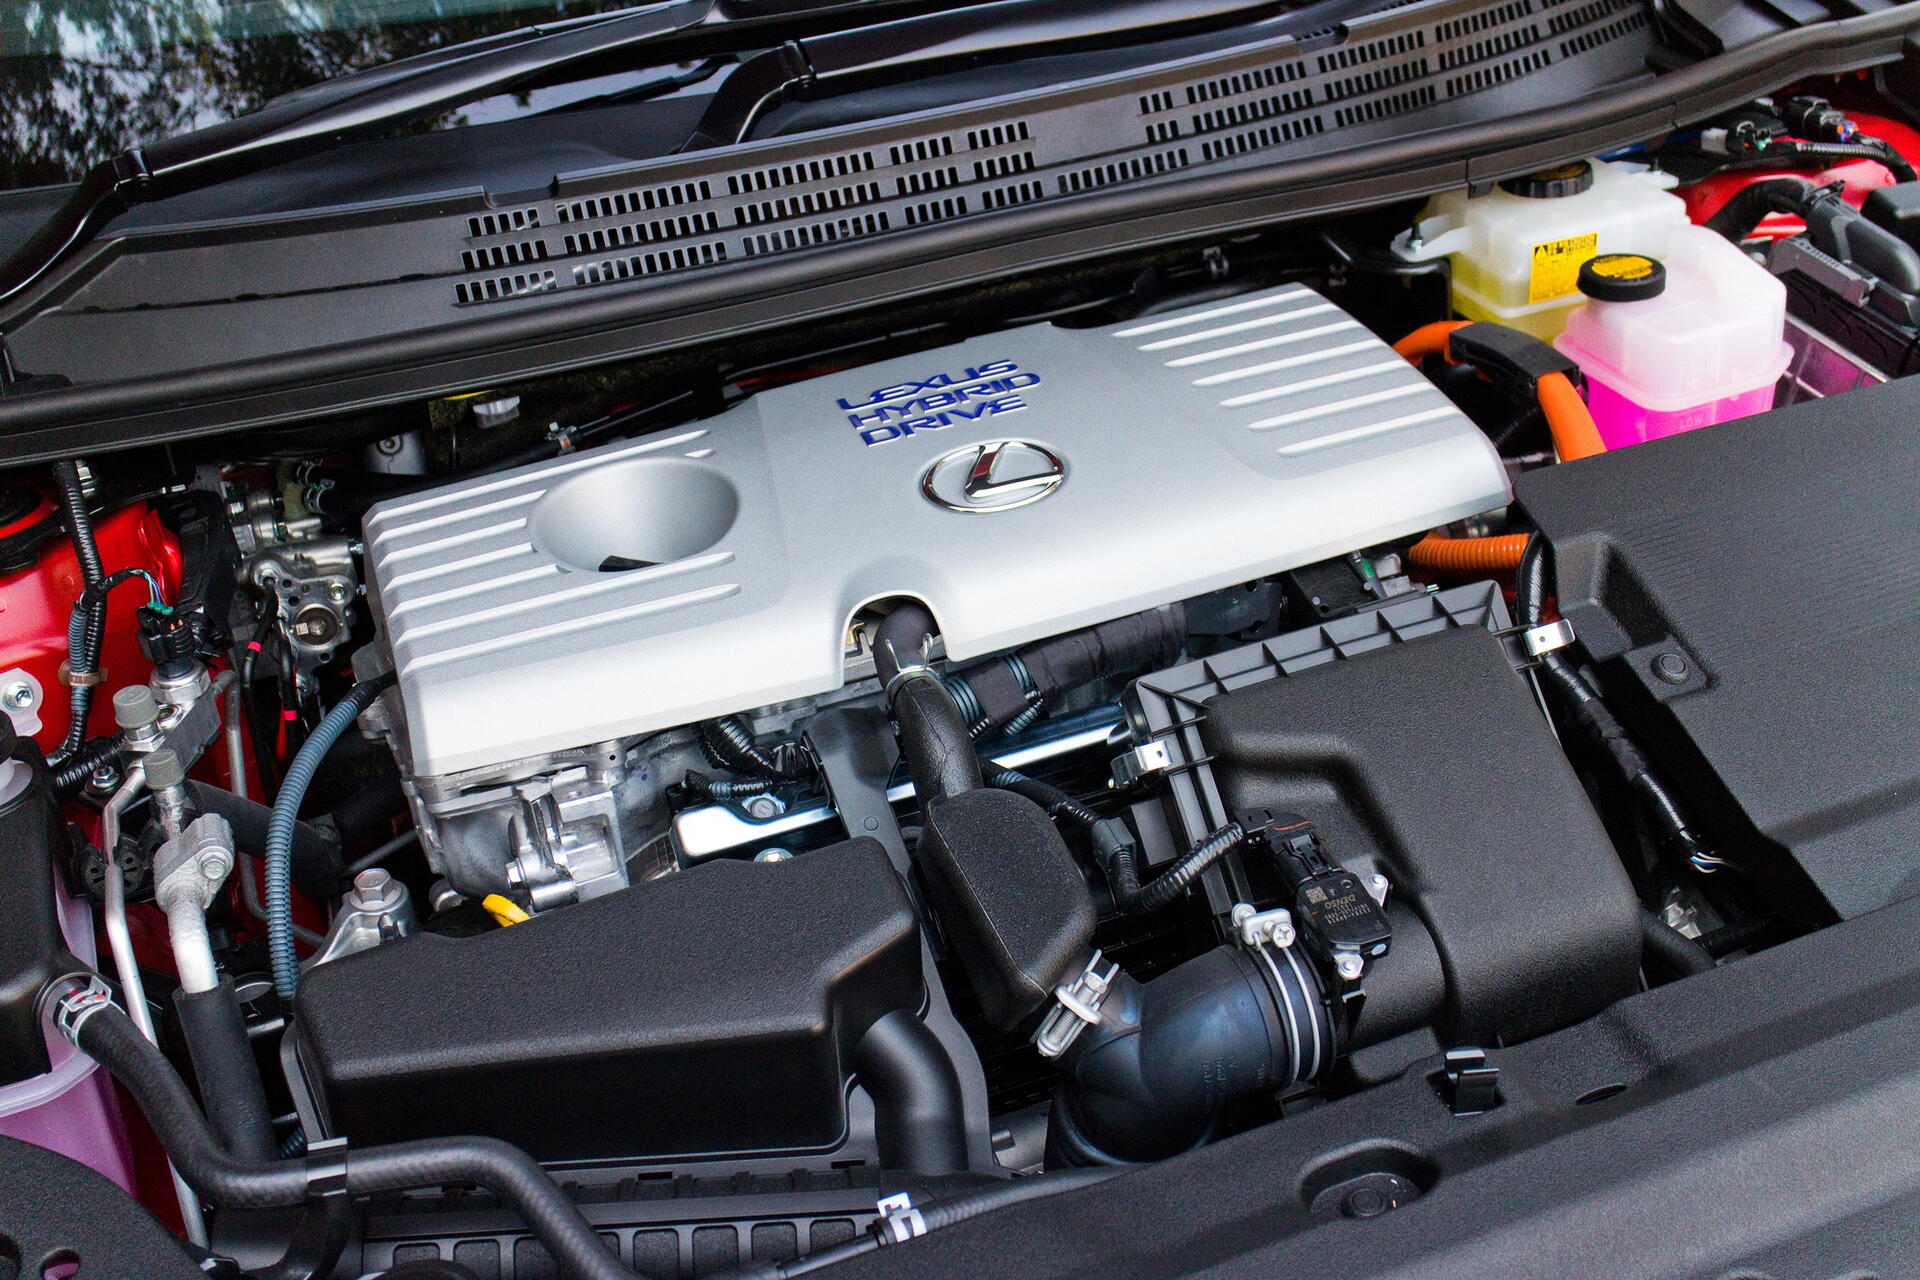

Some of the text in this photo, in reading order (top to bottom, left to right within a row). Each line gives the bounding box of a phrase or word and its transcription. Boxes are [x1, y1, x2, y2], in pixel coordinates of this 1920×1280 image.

[837, 359, 1019, 411] LEXUS
[848, 372, 1041, 430] HYBRID
[860, 394, 1028, 447] DRIVE
[1324, 894, 1356, 909] DENSO
